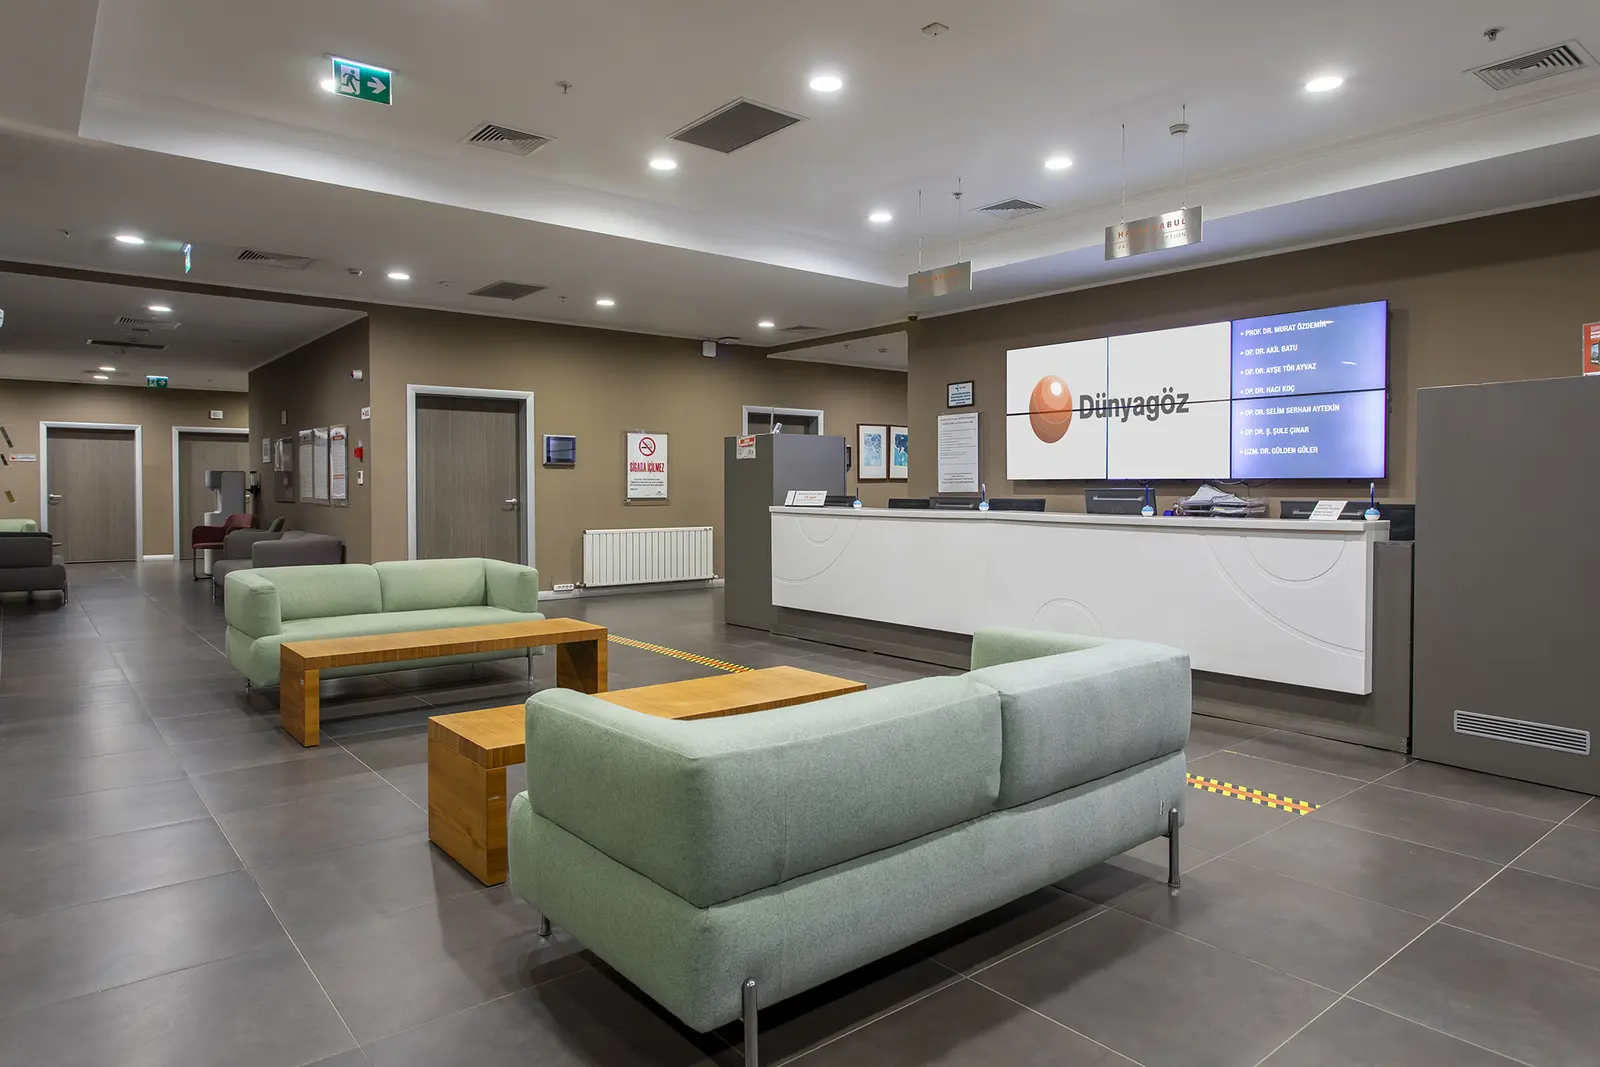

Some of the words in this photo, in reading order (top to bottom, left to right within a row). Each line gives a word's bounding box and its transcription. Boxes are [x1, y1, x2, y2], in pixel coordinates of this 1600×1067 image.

[1263, 327, 1273, 335] DR.
[1274, 324, 1296, 333] MURAT
[1297, 320, 1327, 331] ÖZDEMİR
[1255, 347, 1265, 355] DR.
[1281, 344, 1298, 352] BATU
[1255, 367, 1265, 375] DR.
[1266, 365, 1281, 375] AYŞE
[1296, 362, 1317, 371] AYVAZ
[1266, 385, 1281, 393] HACI
[1282, 384, 1295, 393] KOÇ
[1079, 386, 1190, 423] Dünyagöz
[1255, 408, 1265, 416] DR.
[1266, 406, 1284, 415] SELİM
[1286, 405, 1311, 414] SERHAN
[1312, 403, 1340, 412] AYTEKİN
[1272, 427, 1288, 436] ŞULE
[1289, 426, 1310, 435] ÇINAR
[1271, 446, 1296, 454] GÜLDEN
[1297, 445, 1318, 454] GÜLER
